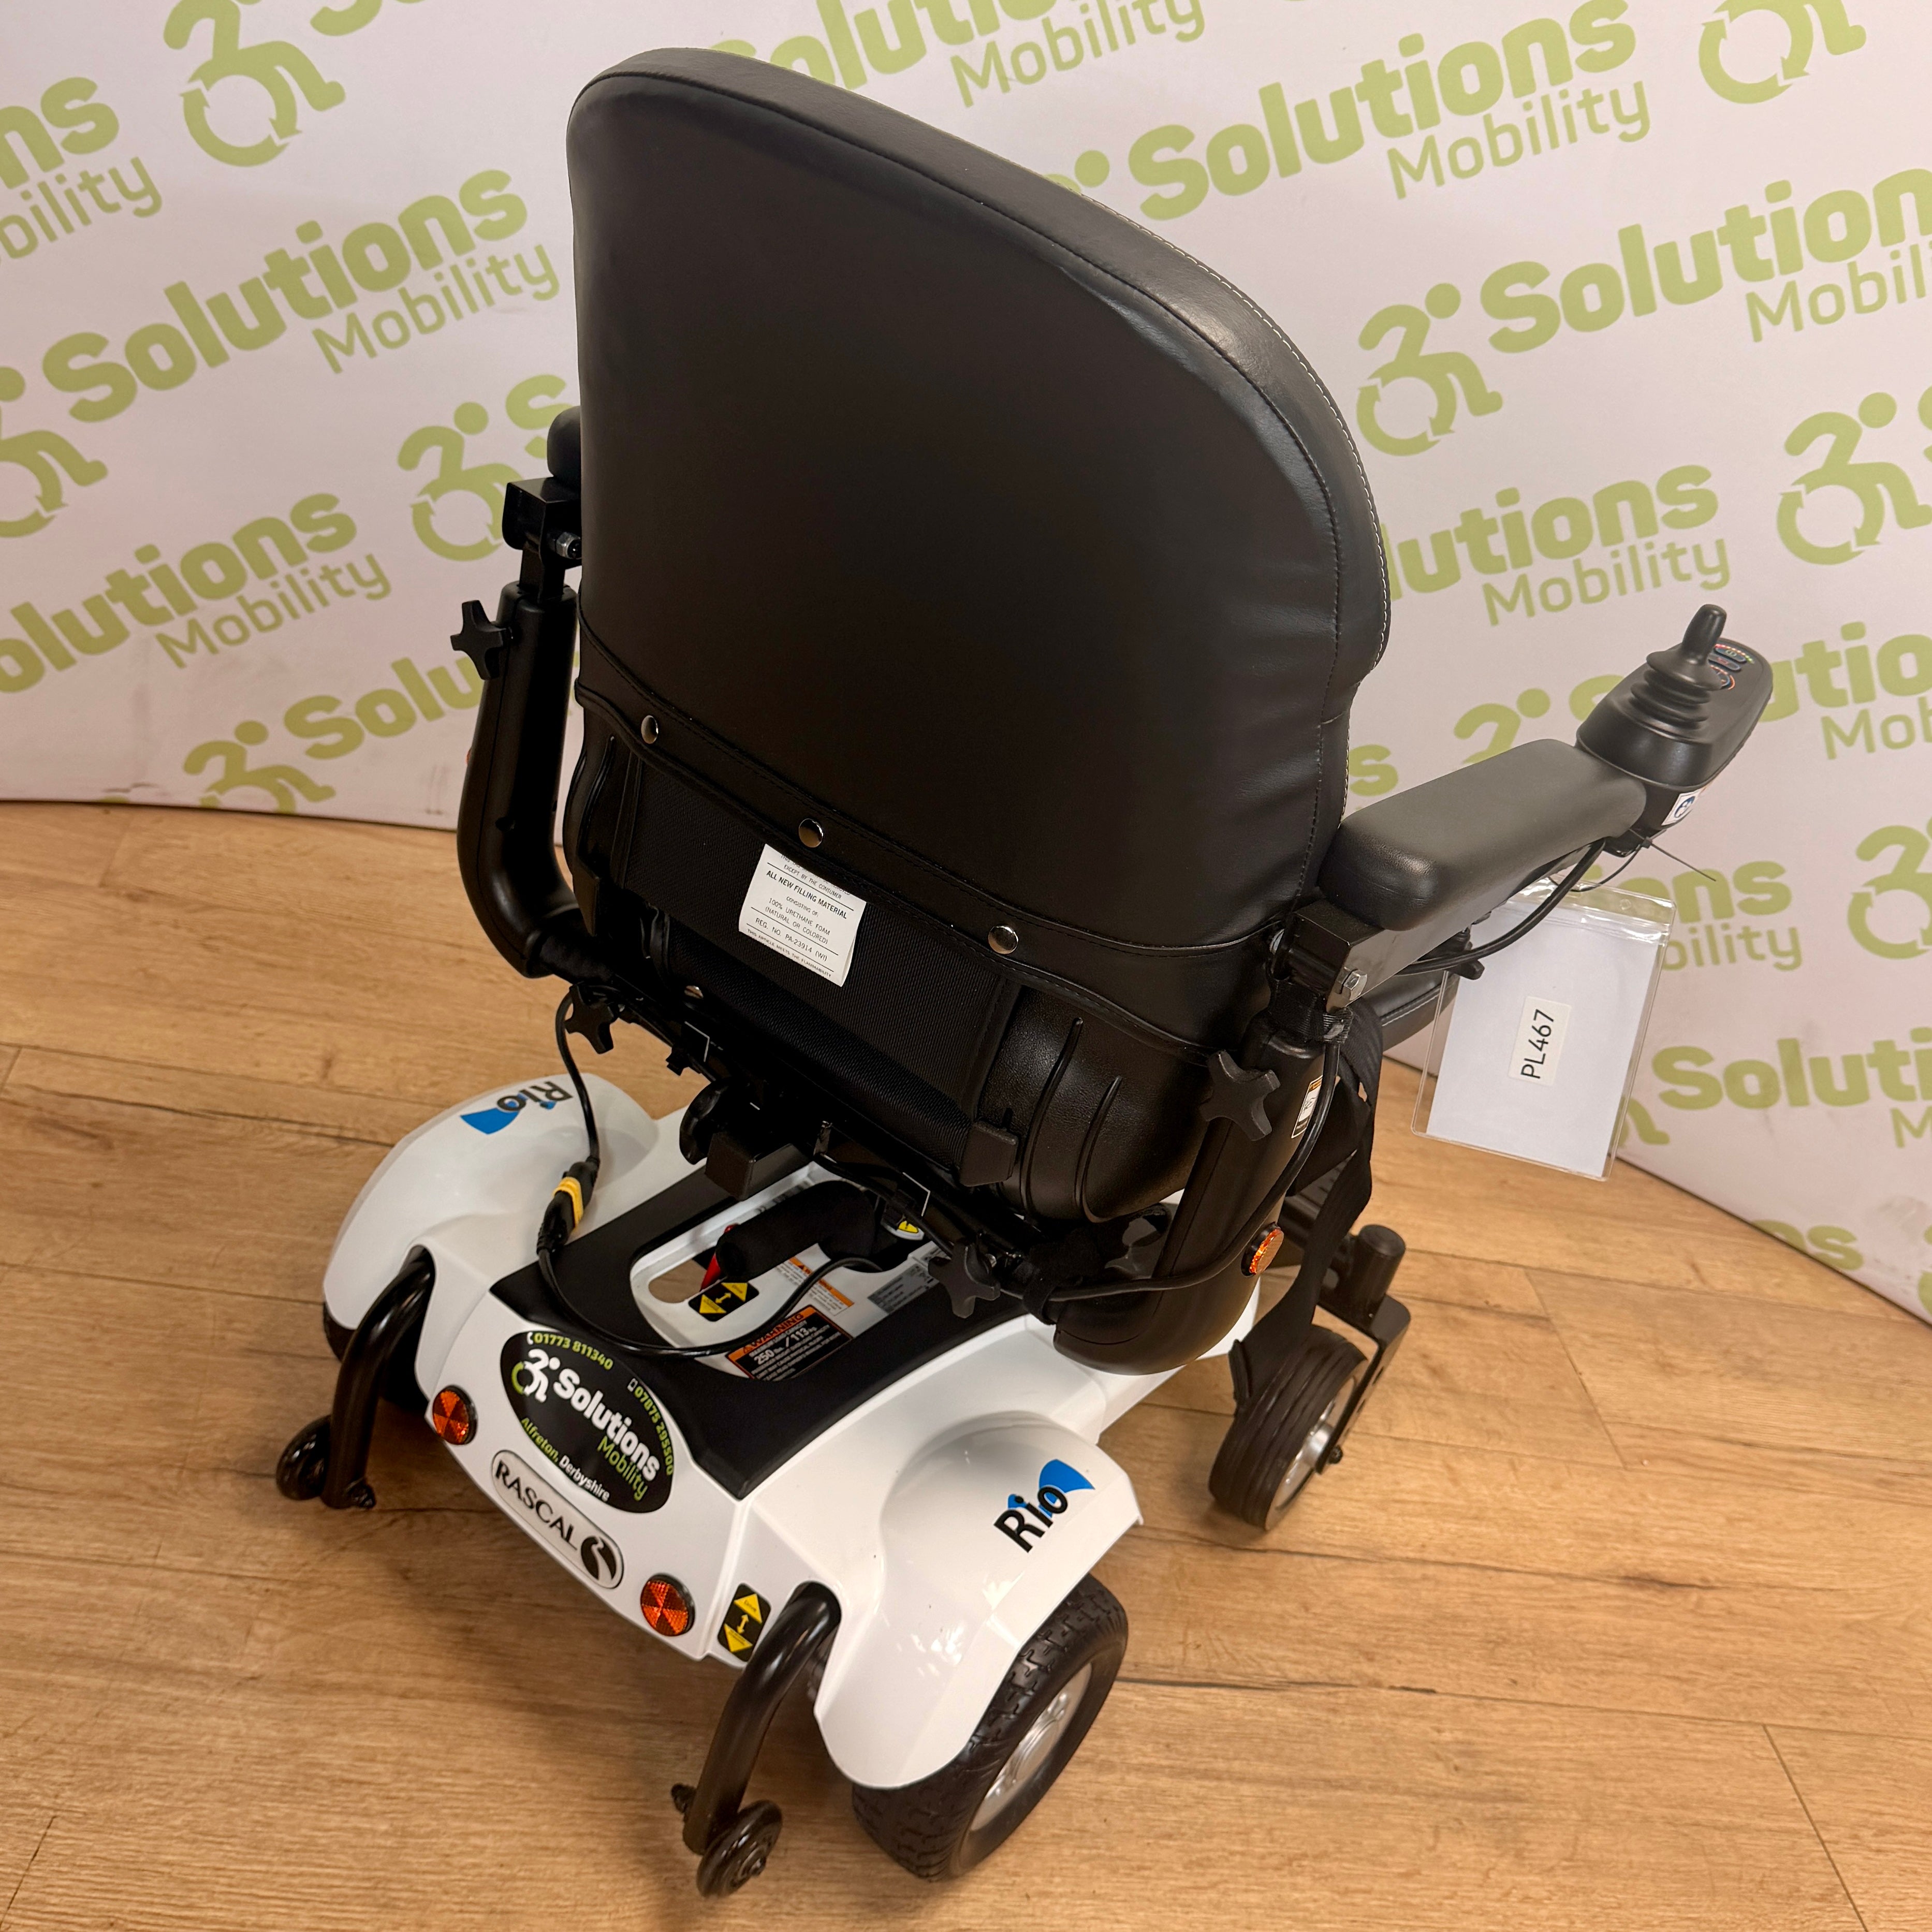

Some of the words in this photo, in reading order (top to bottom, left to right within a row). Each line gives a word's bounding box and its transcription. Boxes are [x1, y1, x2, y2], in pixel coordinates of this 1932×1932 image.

[950, 0, 1205, 108] Mobility
[1128, 0, 1637, 221] Solutions
[1387, 81, 1651, 199] Mobility
[42, 169, 528, 422] Solutions
[311, 244, 560, 374] Mobility
[1745, 240, 1932, 343] Mobil
[155, 554, 392, 669] Mobility
[1482, 538, 1730, 626] Mobility
[755, 918, 768, 930] REG.
[772, 927, 782, 936] NO.
[765, 906, 790, 924] (NATURAL
[802, 927, 828, 945] COLORED)
[766, 870, 777, 881] ALL
[779, 876, 794, 889] NEW
[794, 885, 816, 902] FILLING
[817, 898, 847, 919] MATERIAL
[769, 898, 783, 910] 100%
[785, 907, 813, 926] URETHANE
[815, 924, 830, 935] FOAM
[818, 883, 842, 899] CONSUMER
[1520, 1008, 1554, 1079] PL467
[497, 1081, 573, 1111] Rio
[534, 1332, 570, 1349] 01773
[572, 1340, 614, 1371] 811340
[754, 1350, 775, 1366] 250
[791, 1327, 809, 1343] 113
[521, 1416, 560, 1462] Alfreton,
[559, 1455, 610, 1502] Derbyshire
[553, 1368, 661, 1482] Solutions
[495, 1459, 578, 1552] RASCAL
[597, 1435, 649, 1501] Mobility
[993, 1486, 1069, 1554] Rio
